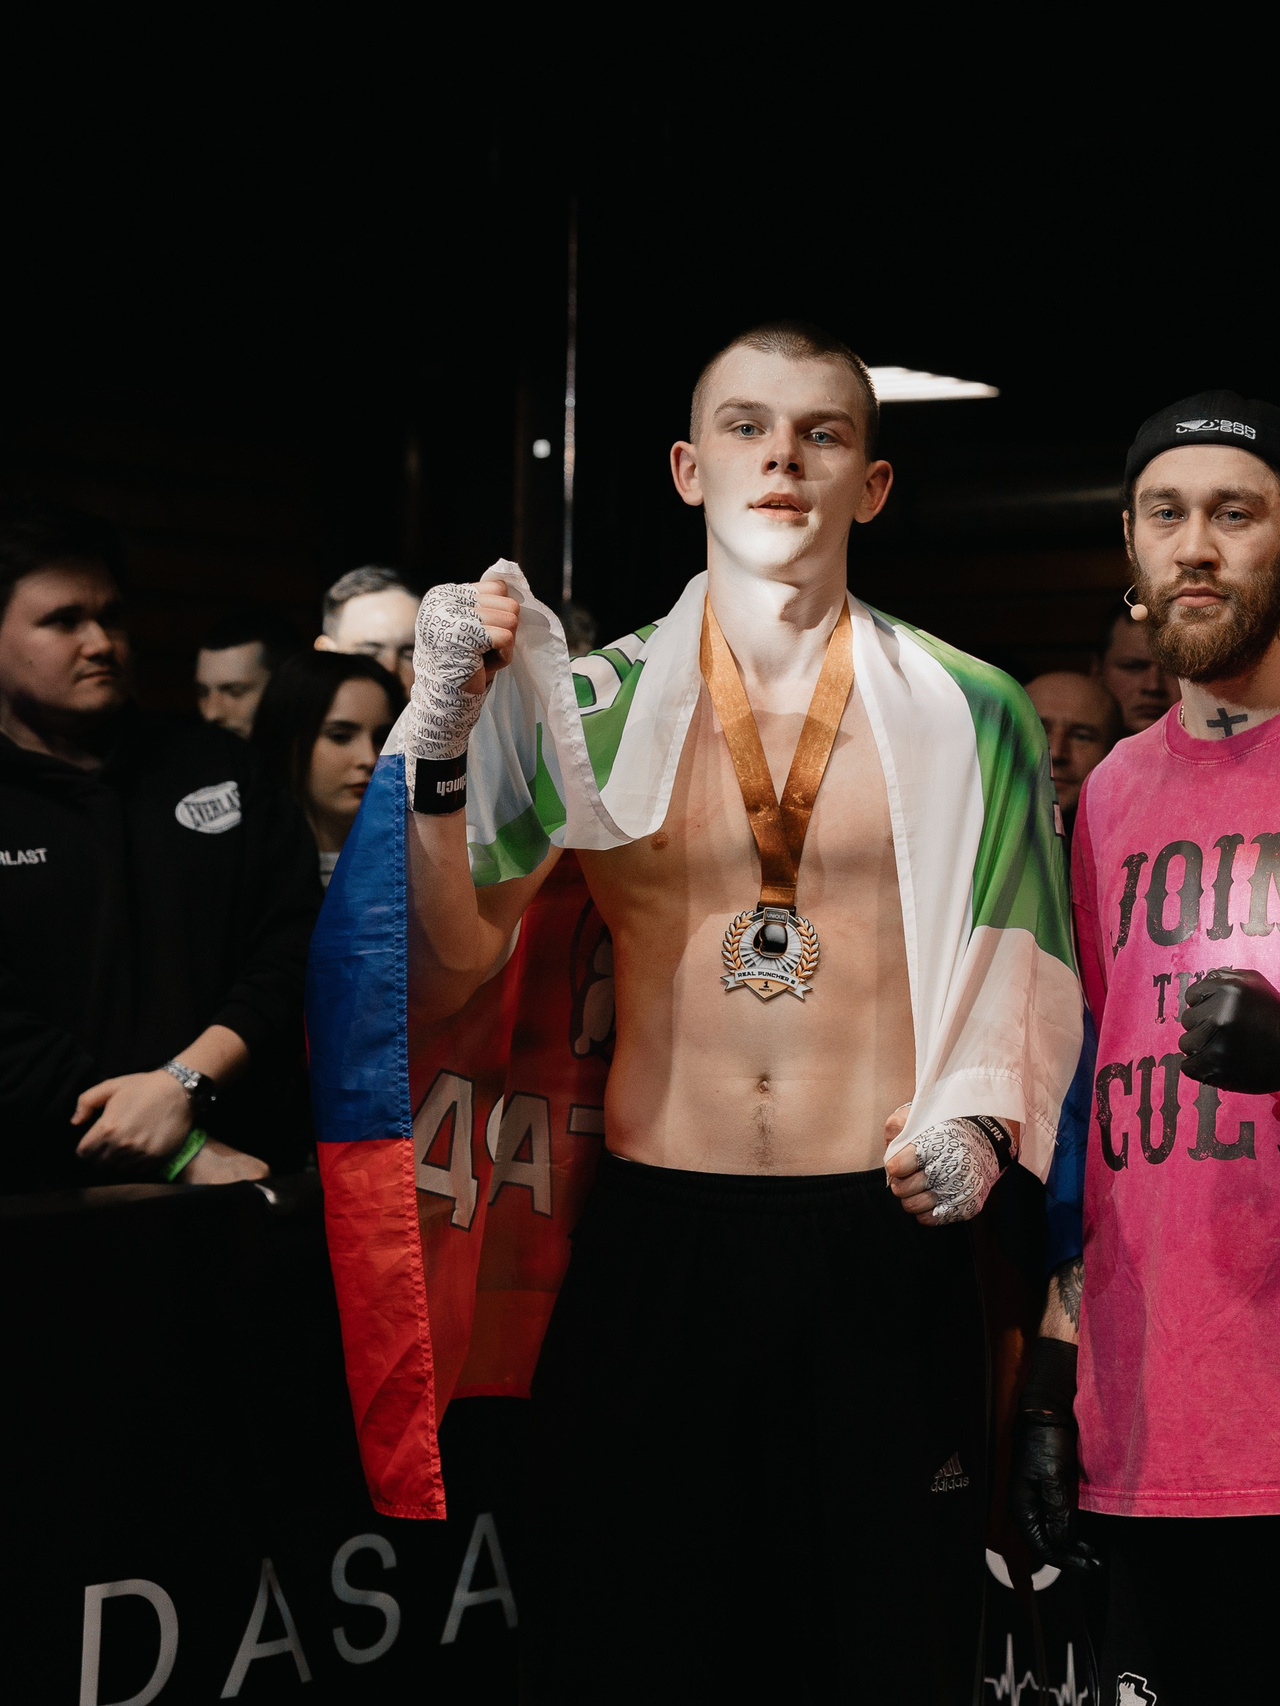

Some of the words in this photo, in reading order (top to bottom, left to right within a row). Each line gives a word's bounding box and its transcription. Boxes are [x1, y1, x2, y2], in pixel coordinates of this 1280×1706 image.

[758, 971, 790, 982] PUNCHER
[990, 1126, 1005, 1142] FIX
[930, 1475, 970, 1493] adidas
